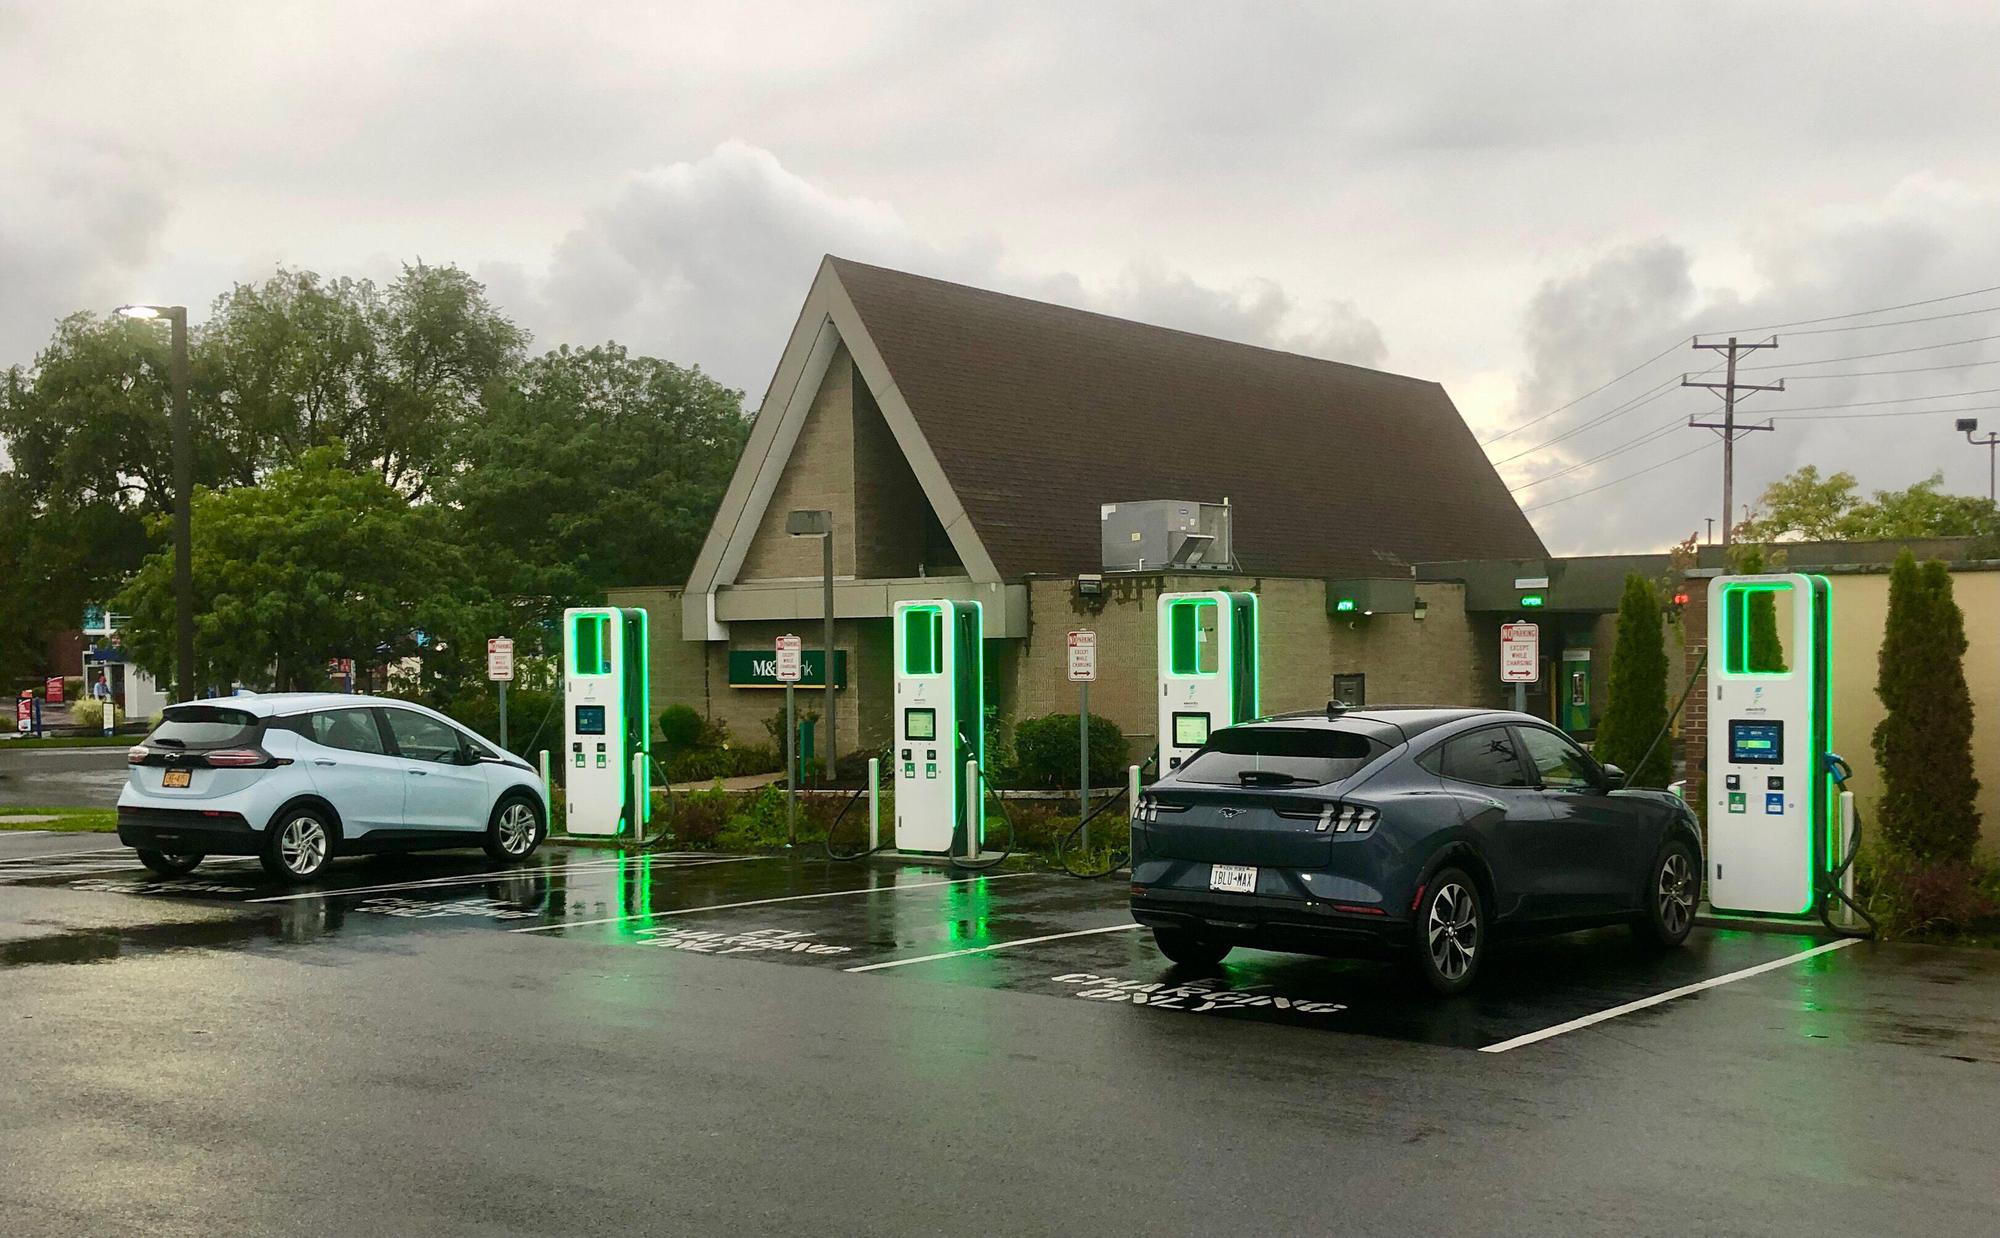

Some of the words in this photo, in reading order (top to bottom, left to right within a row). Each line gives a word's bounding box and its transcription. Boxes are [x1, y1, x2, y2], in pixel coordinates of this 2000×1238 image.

[1337, 601, 1353, 610] ATM
[1522, 597, 1542, 606] OPEN
[1503, 629, 1513, 639] NO
[1513, 630, 1535, 638] PARKING
[753, 660, 776, 676] M&
[1051, 973, 1348, 1013] CHARGING
